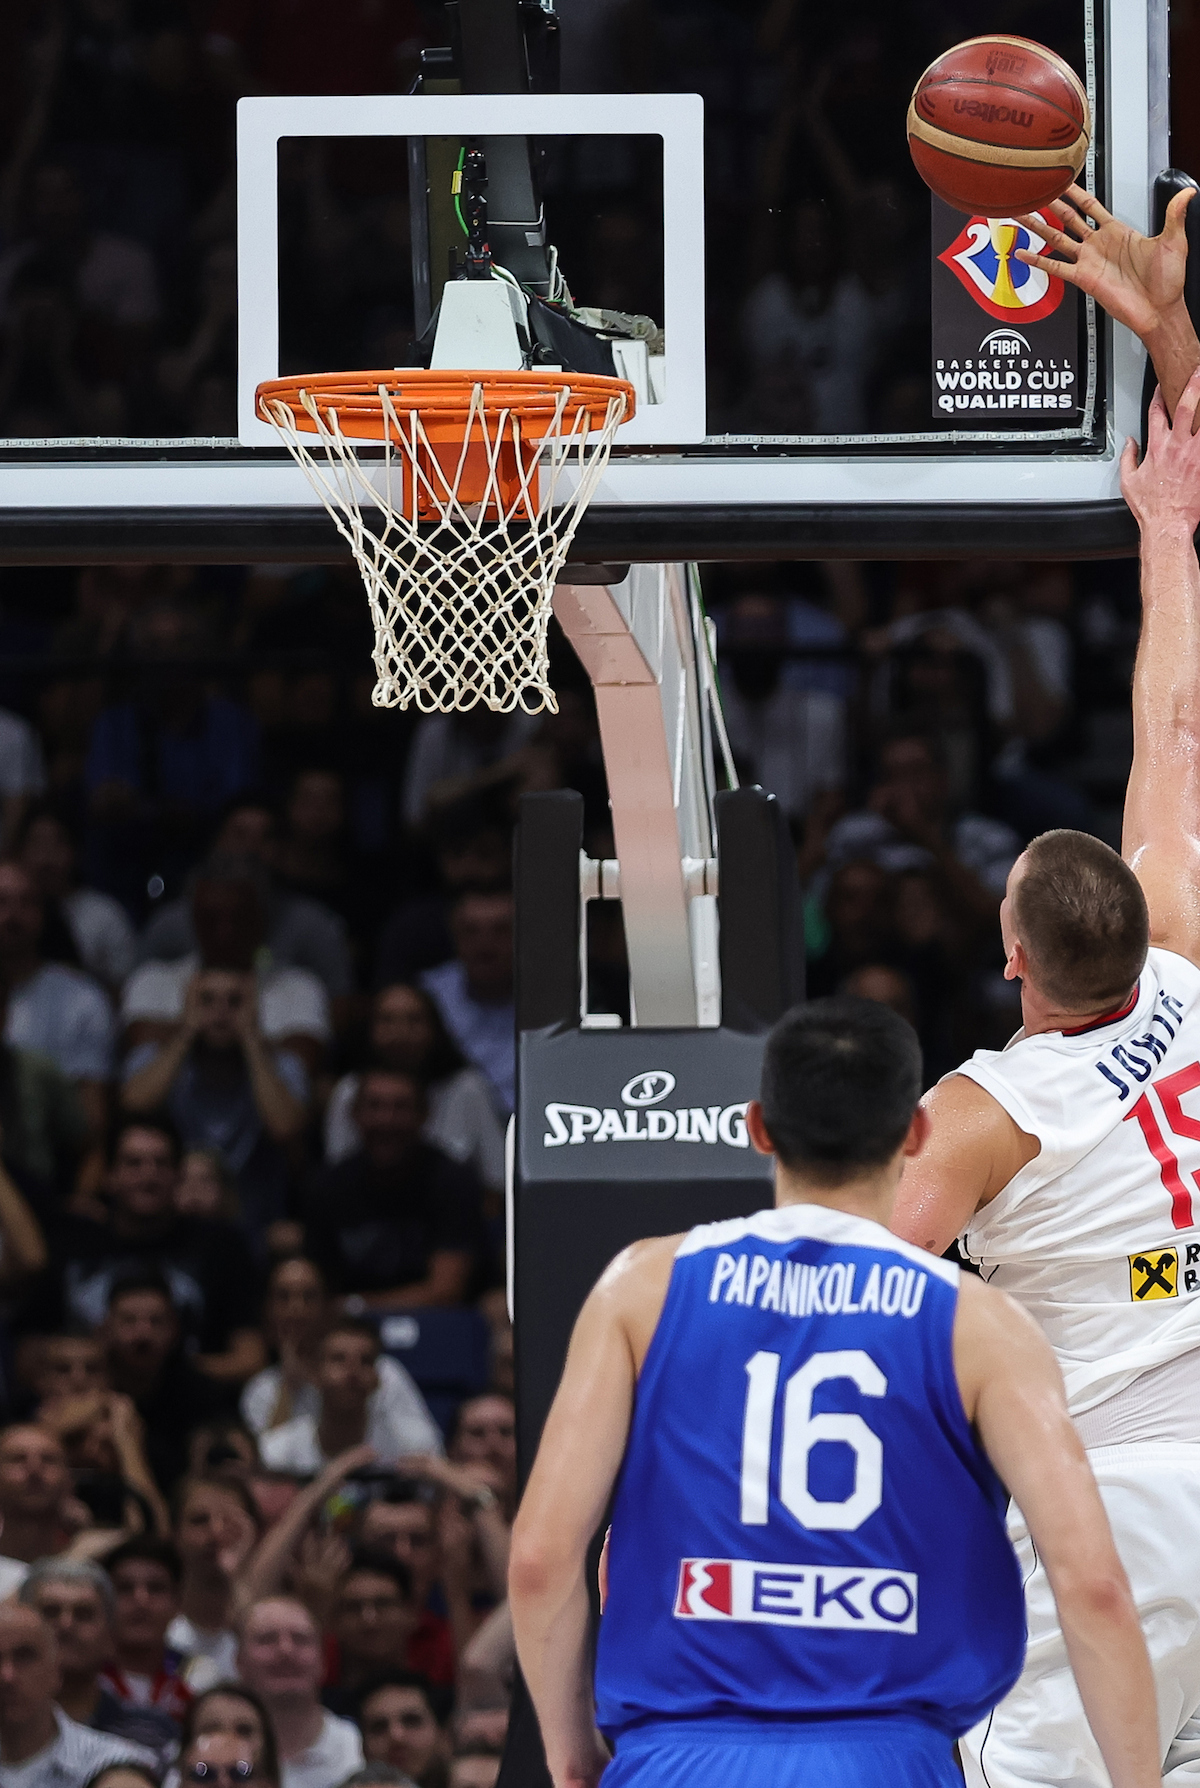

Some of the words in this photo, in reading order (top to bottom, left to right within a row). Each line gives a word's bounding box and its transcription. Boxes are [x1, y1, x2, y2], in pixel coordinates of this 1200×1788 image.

[953, 99, 1034, 127] molten
[989, 340, 1020, 355] FIBA
[937, 359, 1071, 369] BASKETBALL
[935, 371, 1022, 390] WORLD
[1027, 371, 1075, 390] CUP
[938, 394, 1073, 413] QUALIFIERS
[544, 1102, 750, 1148] SPALDING
[709, 1253, 927, 1318] PAPANIKOLAOU
[740, 1349, 888, 1531] 16
[752, 1570, 914, 1623] EKO
